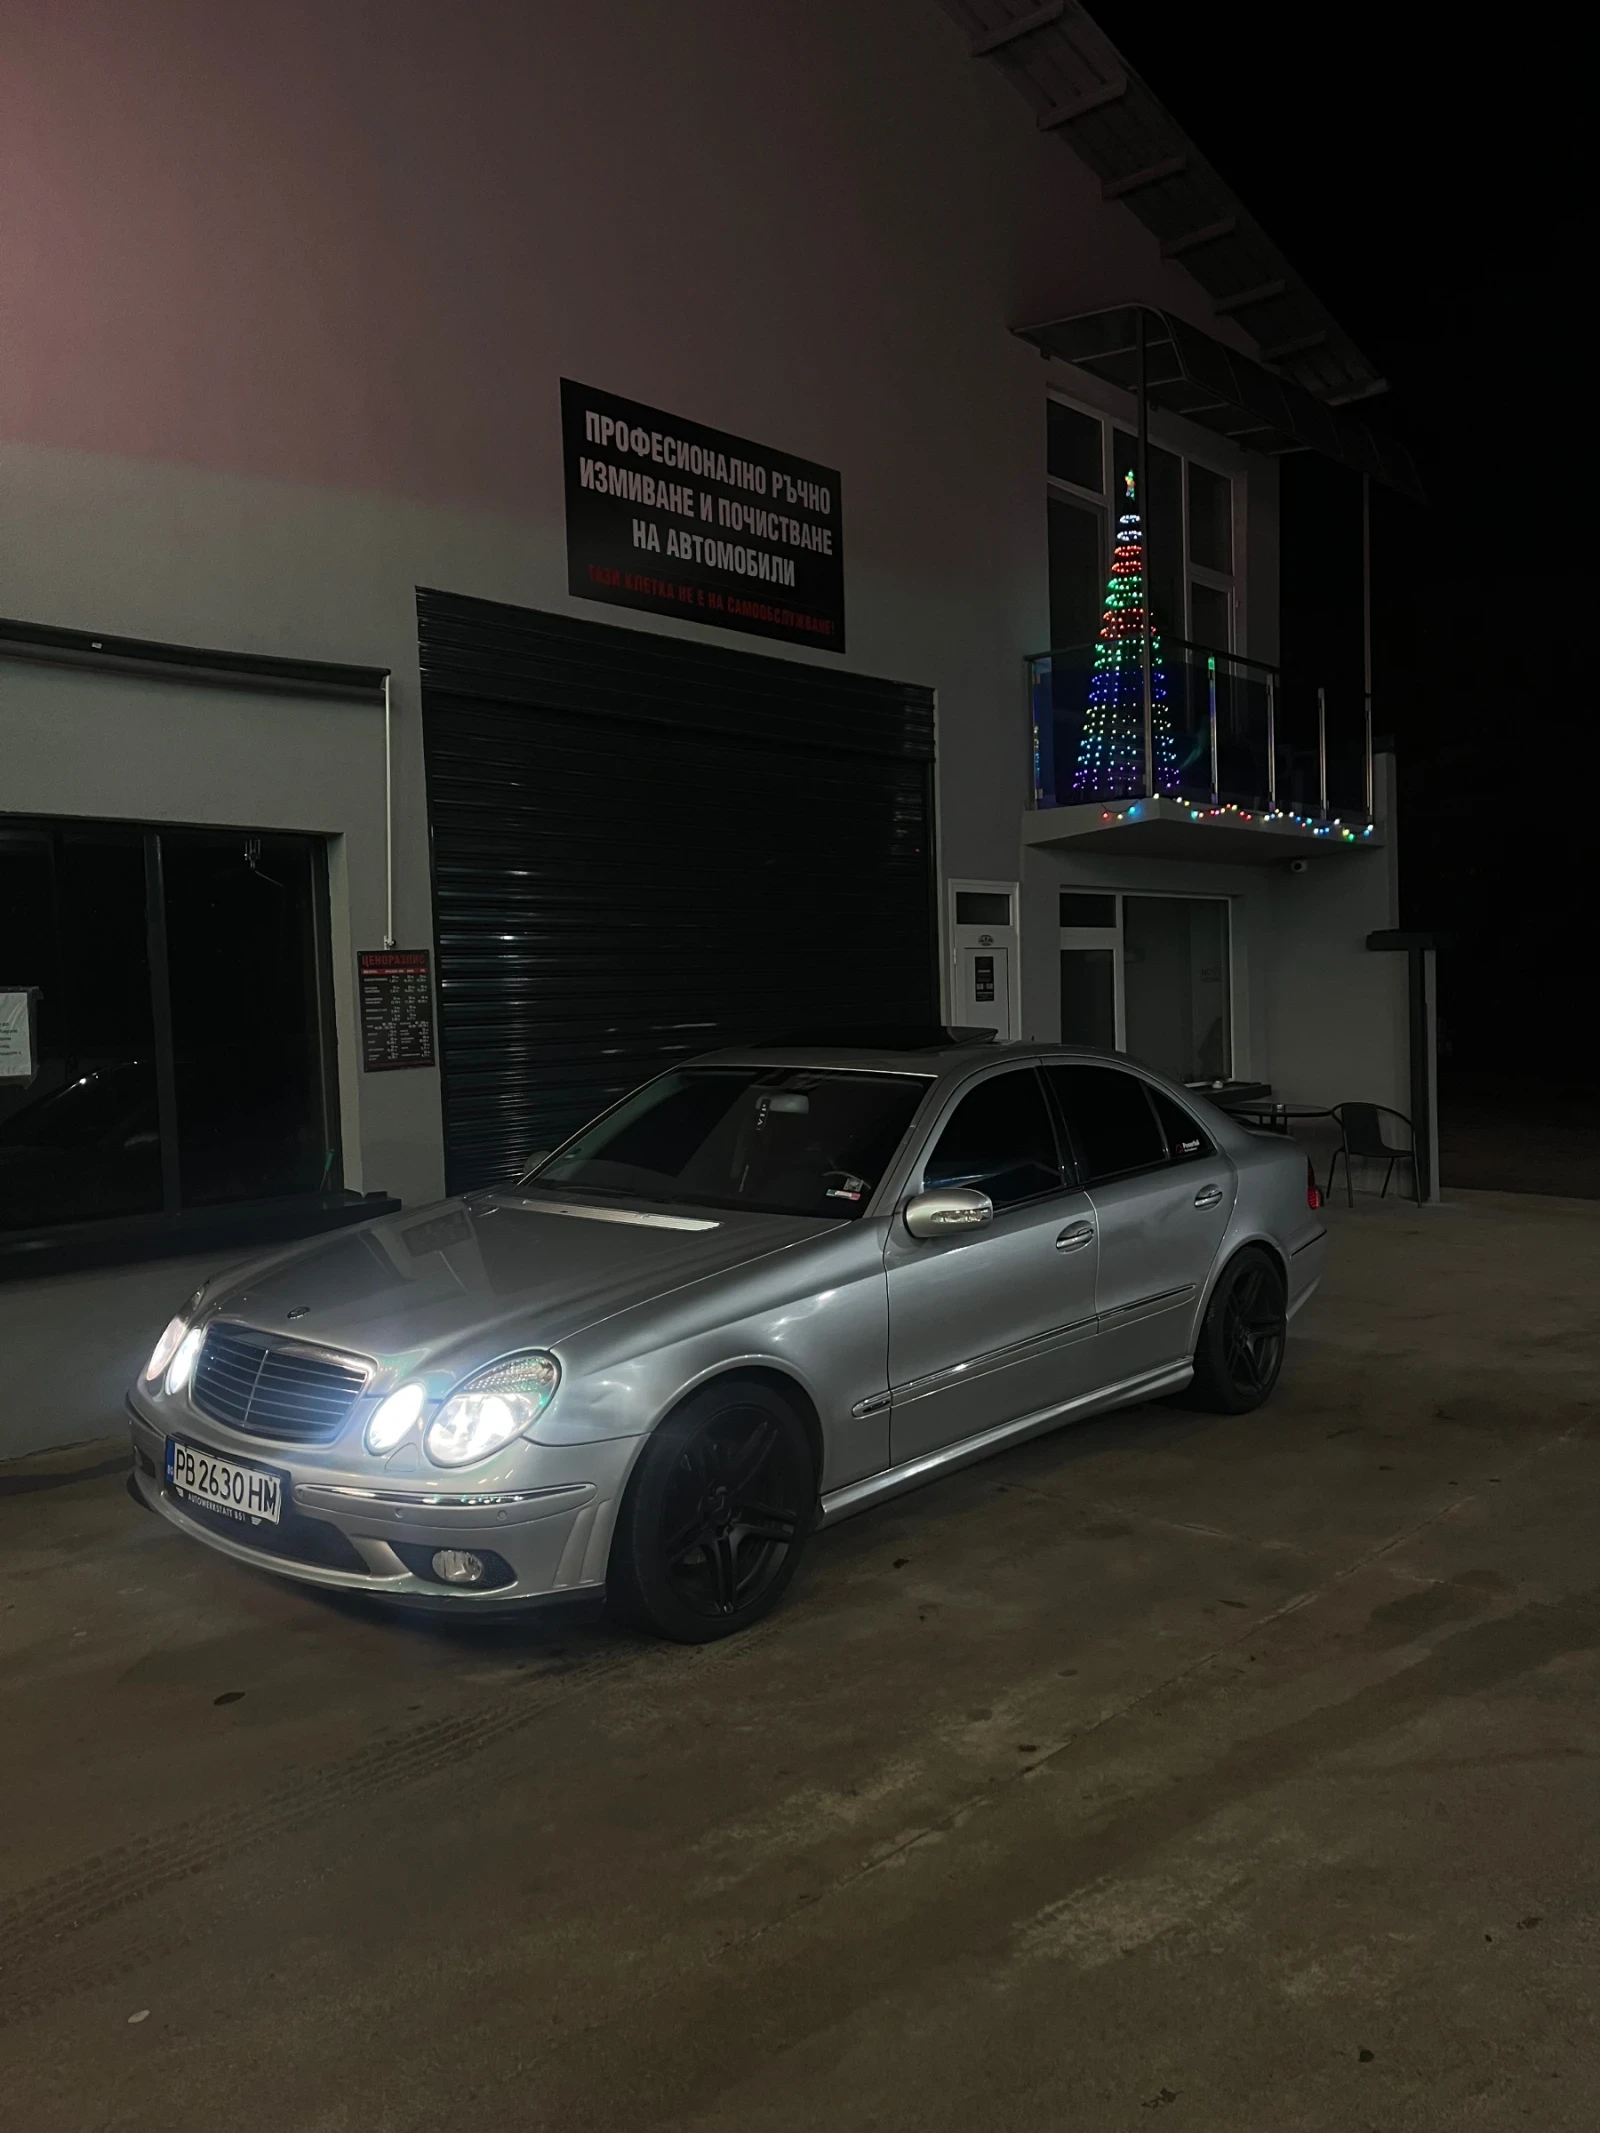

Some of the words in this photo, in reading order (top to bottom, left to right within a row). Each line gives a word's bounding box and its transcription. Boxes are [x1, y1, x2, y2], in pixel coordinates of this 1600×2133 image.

[584, 410, 766, 496] ПРОФЕСИОНАЛНО
[771, 470, 831, 515] РЪЧНО
[579, 456, 694, 518] ИЗМИВАНЕ
[699, 492, 713, 522] И
[717, 497, 833, 556] ПОЧИСТВАНЕ
[632, 518, 661, 553] НА
[666, 528, 796, 587] АВТОМОБИЛИ
[624, 573, 674, 600] КЛЕТКА
[678, 585, 693, 604] НЕ
[697, 588, 705, 607] Е
[708, 591, 724, 610] НА
[362, 954, 425, 967] ЦЕНОРАЗПИС
[199, 1460, 244, 1504] 2630
